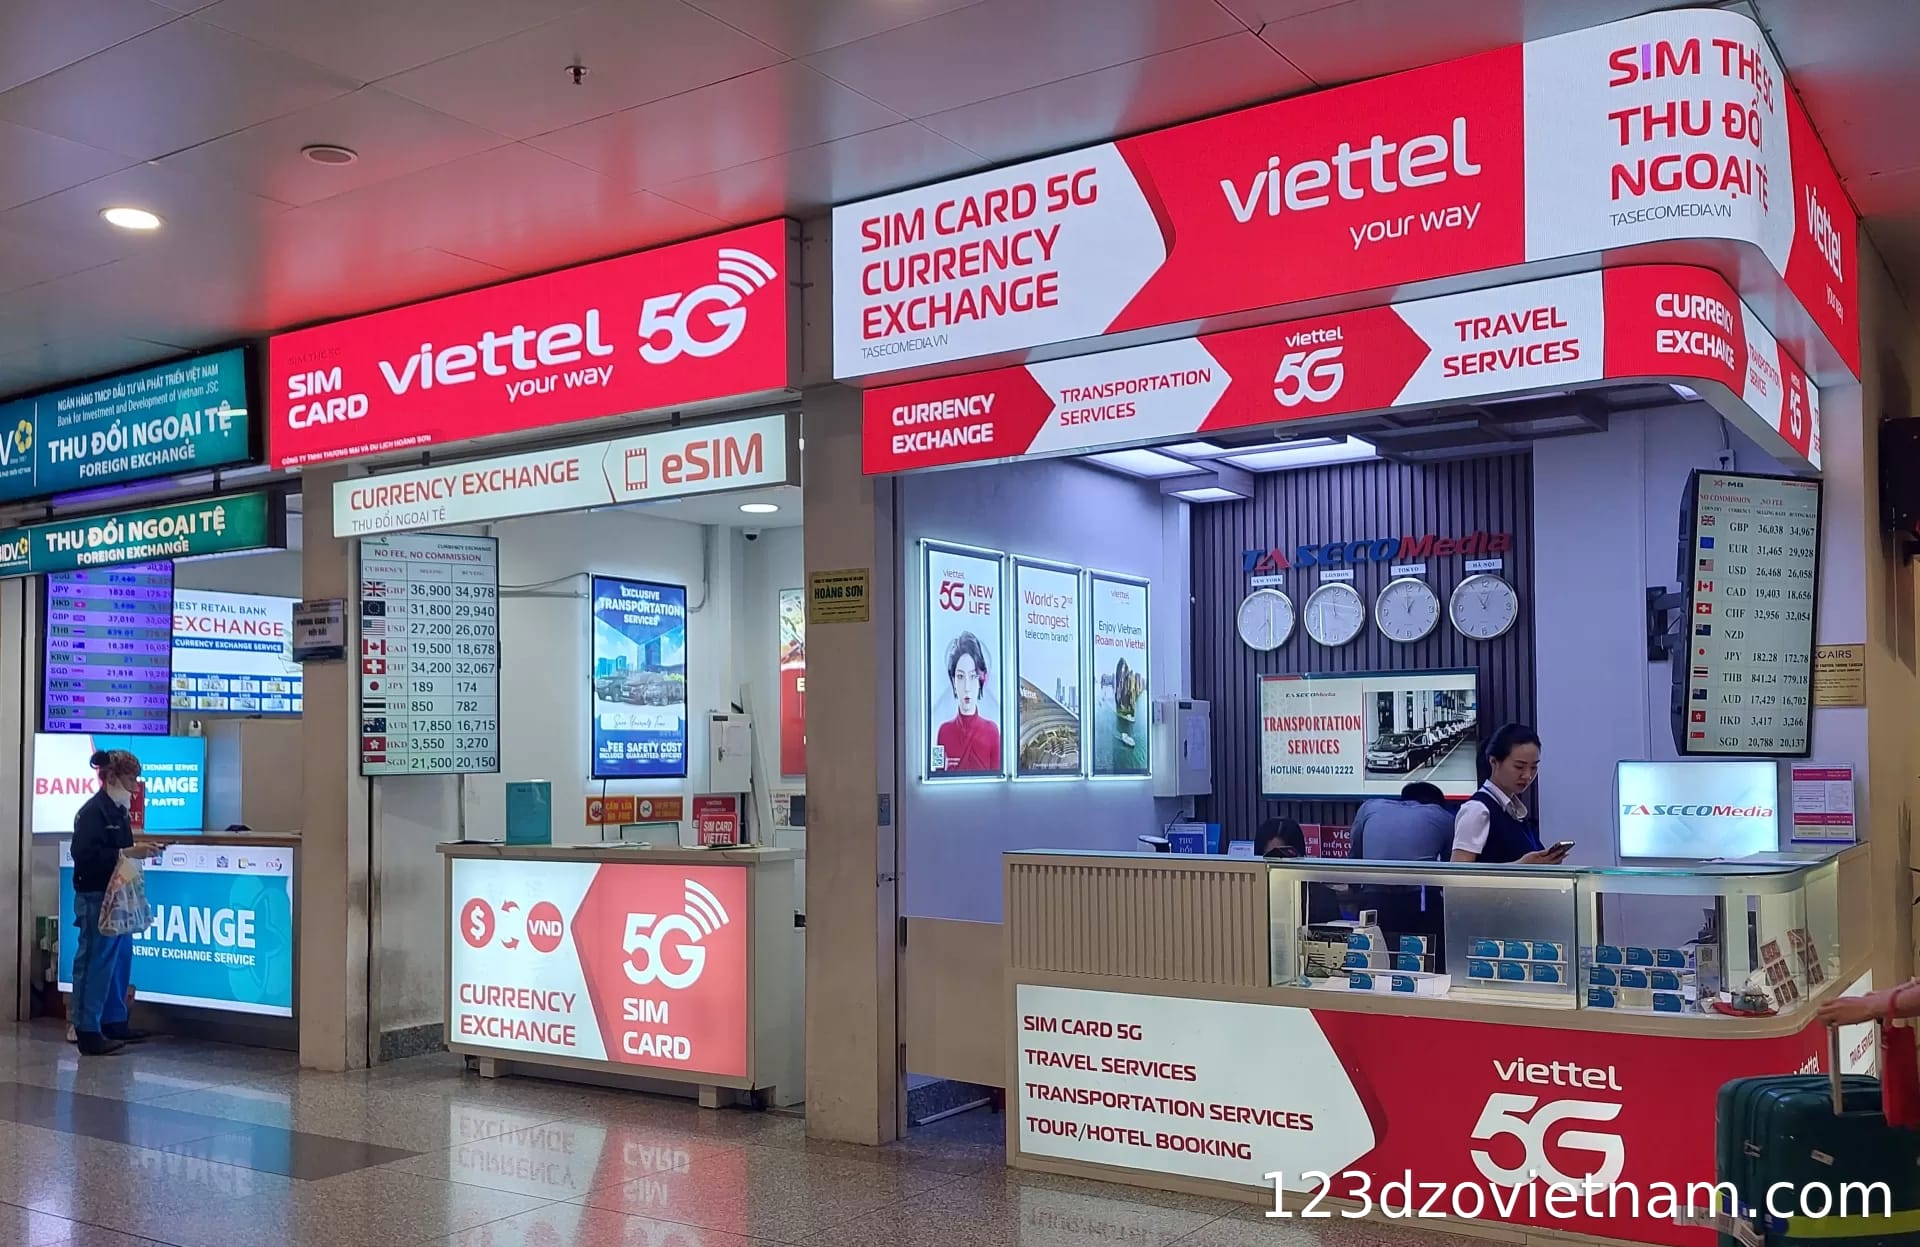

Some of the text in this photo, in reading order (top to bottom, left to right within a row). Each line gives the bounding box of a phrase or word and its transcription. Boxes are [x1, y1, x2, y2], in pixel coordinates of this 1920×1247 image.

[1609, 38, 1700, 88] SIM
[1608, 100, 1711, 146] THU
[1220, 116, 1481, 224] viettel
[1611, 153, 1751, 200] NGOẠI
[862, 168, 1097, 252] SIM CARD 5G
[1609, 204, 1732, 226] TASECOMEDIA.VN
[1350, 202, 1481, 250] your way
[862, 224, 1061, 296] CURRENCY
[863, 272, 1058, 340] EXCHANGE
[1656, 293, 1734, 336] CURRENCY
[1454, 306, 1568, 342] TRAVEL
[378, 284, 748, 396] viettel 5G
[862, 334, 948, 360] TASECOMEDIA.VN
[1285, 326, 1344, 348] viettel
[1443, 338, 1580, 378] SERVICES
[1656, 330, 1734, 370] EXCHANGE
[288, 366, 342, 399] SIM
[506, 364, 614, 404] your way
[1060, 368, 1212, 404] TRANSPORTATION
[1273, 346, 1344, 407] 5G
[82, 393, 168, 421] Investment Development
[288, 393, 368, 429] CARD
[892, 394, 996, 426] CURRENCY
[1060, 402, 1136, 426] SERVICES
[48, 400, 231, 463] THU ĐỔI NGOẠI TỆ
[892, 423, 994, 454] EXCHANGE
[80, 444, 195, 478] FOREIGN EXCHANGE
[661, 432, 762, 484] eSIM
[350, 458, 579, 511] CURRENCY EXCHANGE
[46, 506, 225, 552] THU ĐỔI NGOẠI TỆ
[352, 511, 429, 532] THU NGOẠI
[1730, 522, 1815, 537] GBP 36,038 34,967
[78, 540, 188, 564] FOREIGN EXCHANGE
[425, 552, 481, 562] COMMISSION
[1729, 544, 1814, 559] EUR 31,465 29,928
[1728, 566, 1813, 579] USD 26,468 26,058
[411, 585, 494, 598] 36,900 34,978
[622, 587, 660, 600] EXCLUSIVE
[814, 584, 863, 600] HOÀNG SƠN
[940, 580, 994, 612] 5G NEW
[1024, 590, 1058, 608] World's
[1726, 587, 1811, 601] CAD 19,403 18,656
[201, 604, 267, 616] RETAIL BANK
[411, 604, 494, 617] 31,800 29,940
[599, 598, 681, 616] TRANSPORTATION
[969, 602, 990, 616] LIFE
[1726, 608, 1810, 622] CHF 32,956 32,054
[174, 616, 284, 636] EXCHANGE
[411, 623, 494, 636] 27,200 26,070
[1028, 611, 1069, 630] strongest
[1099, 620, 1142, 636] Enjoy Vietnam
[1025, 630, 1050, 641] telecom
[1096, 634, 1144, 650] Roam Viettel
[1724, 630, 1744, 639] NZD
[175, 639, 282, 652] CURRENCY EXCHANGE SERVICE
[412, 642, 494, 655] 19,500 18,678
[1724, 651, 1809, 664] JPY 182.28 172.78
[412, 662, 494, 675] 34,200 32,067
[412, 681, 477, 692] 189 174
[1723, 673, 1808, 685] THB 841.24 779.18
[412, 701, 477, 712] 850 782
[1721, 695, 1807, 707] AUD 17,429 16,702
[413, 720, 495, 733] 17,850 16,715
[1264, 715, 1361, 732] TRANSPORTATION
[1720, 716, 1803, 728] HKD 3,417 3,266
[412, 738, 488, 750] 3,550 3,270
[627, 742, 682, 752] SAFETY COST
[1288, 739, 1340, 754] SERVICES
[1719, 737, 1805, 748] SGD 20,788 20,137
[412, 756, 495, 769] 21,500 20,150
[1270, 766, 1354, 774] HOTLINE: 0944012222
[35, 778, 95, 796] BANK
[1622, 804, 1773, 818] TASECOMedia
[716, 821, 732, 832] CARD
[704, 833, 732, 844] VIETTEL
[528, 920, 562, 936] VND
[162, 948, 256, 966] EXCHANGE SERVICE
[622, 913, 706, 990] 5G
[460, 984, 576, 1014] CURRENCY
[623, 997, 668, 1025] SIM
[461, 1014, 576, 1047] EXCHANGE
[1024, 1016, 1142, 1040] SIM CARD 5G
[624, 1031, 691, 1060] CARD
[1025, 1049, 1196, 1082] TRAVEL SERVICES
[1492, 1056, 1622, 1091] viettel
[1026, 1082, 1314, 1131] TRANSPORTATION SERVICES
[1026, 1116, 1252, 1160] TOUR/HOTEL BOOKING
[1470, 1092, 1624, 1197] 5G
